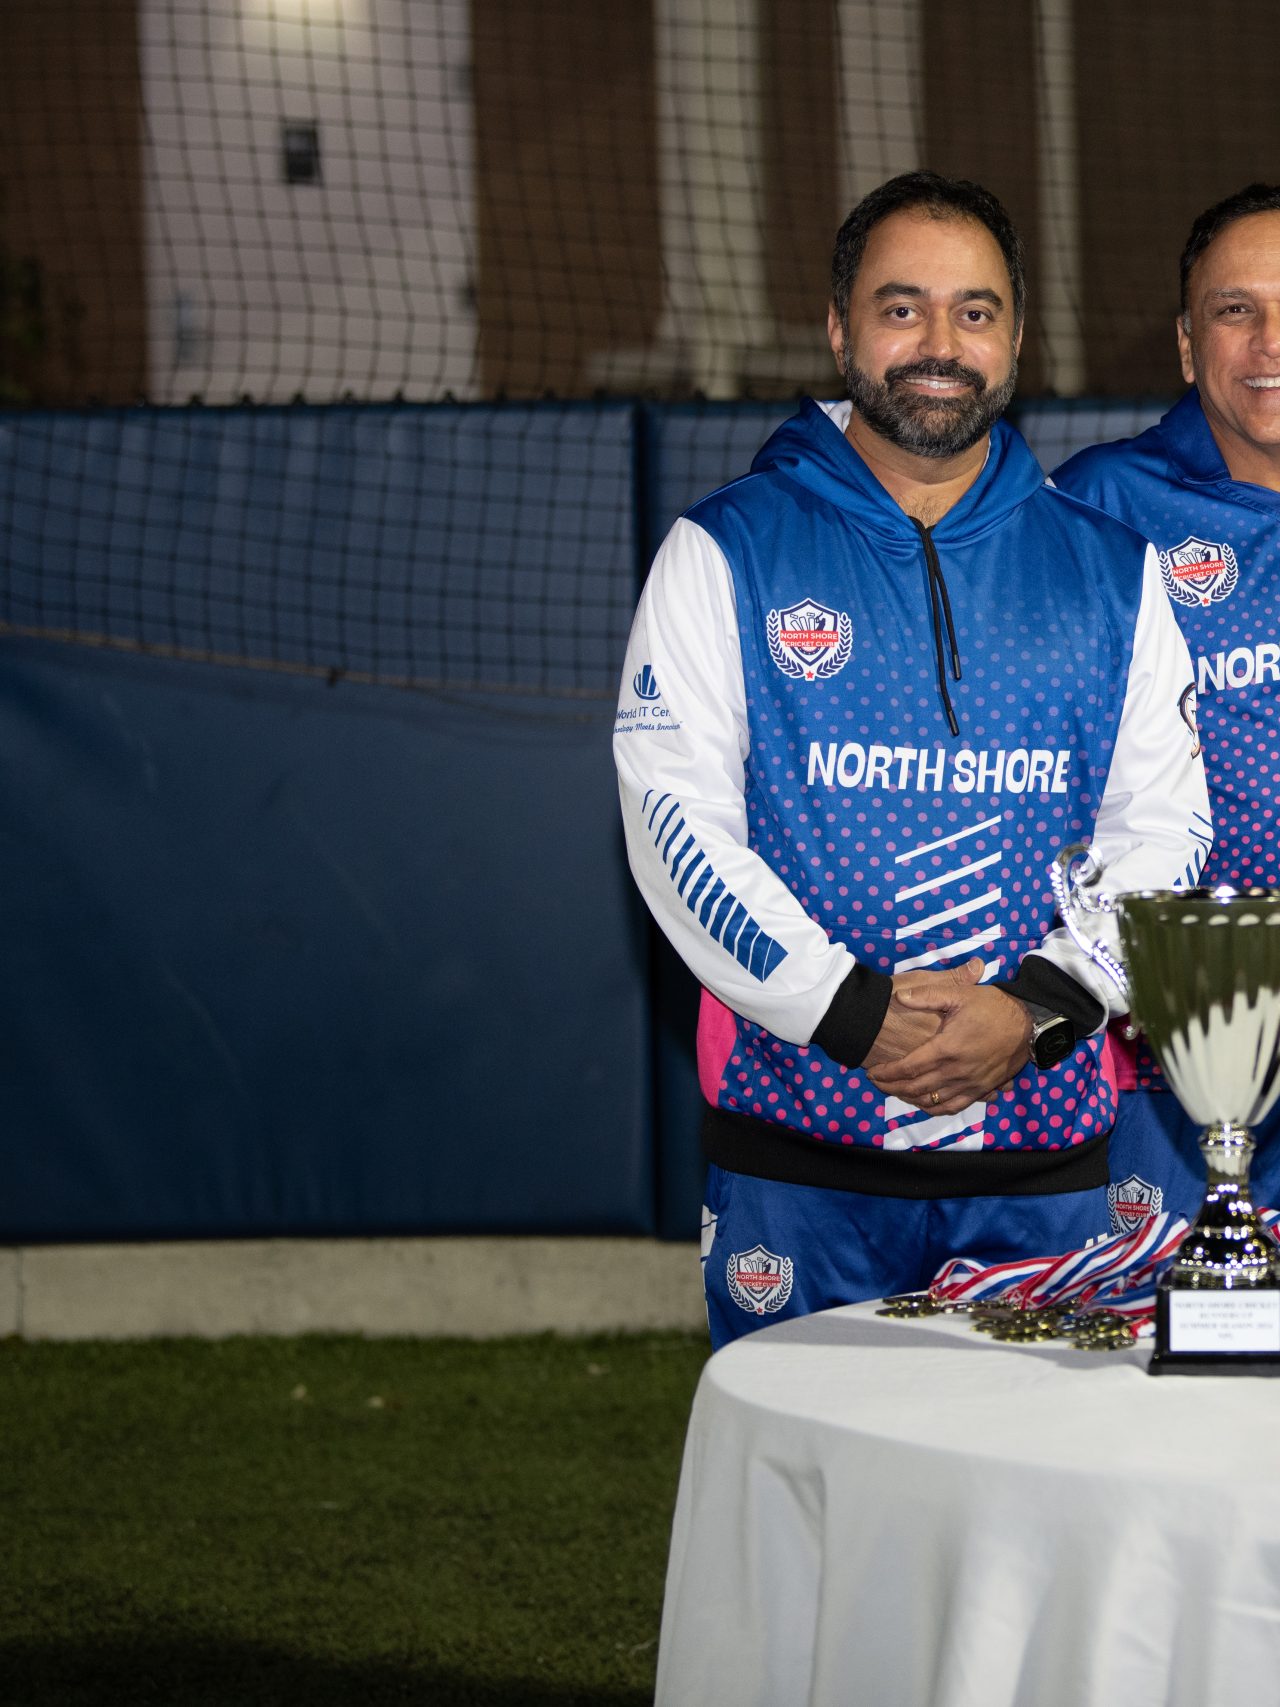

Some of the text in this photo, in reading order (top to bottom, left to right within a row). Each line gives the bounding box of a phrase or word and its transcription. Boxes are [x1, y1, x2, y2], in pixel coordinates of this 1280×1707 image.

[1173, 561, 1225, 576] NORTH SHORE
[1179, 569, 1222, 581] CRICKET CLUB
[781, 632, 838, 640] NORTH SHORE
[639, 706, 648, 717] IT
[807, 742, 1071, 794] NORTH SHORE
[758, 1274, 781, 1282] SHORE
